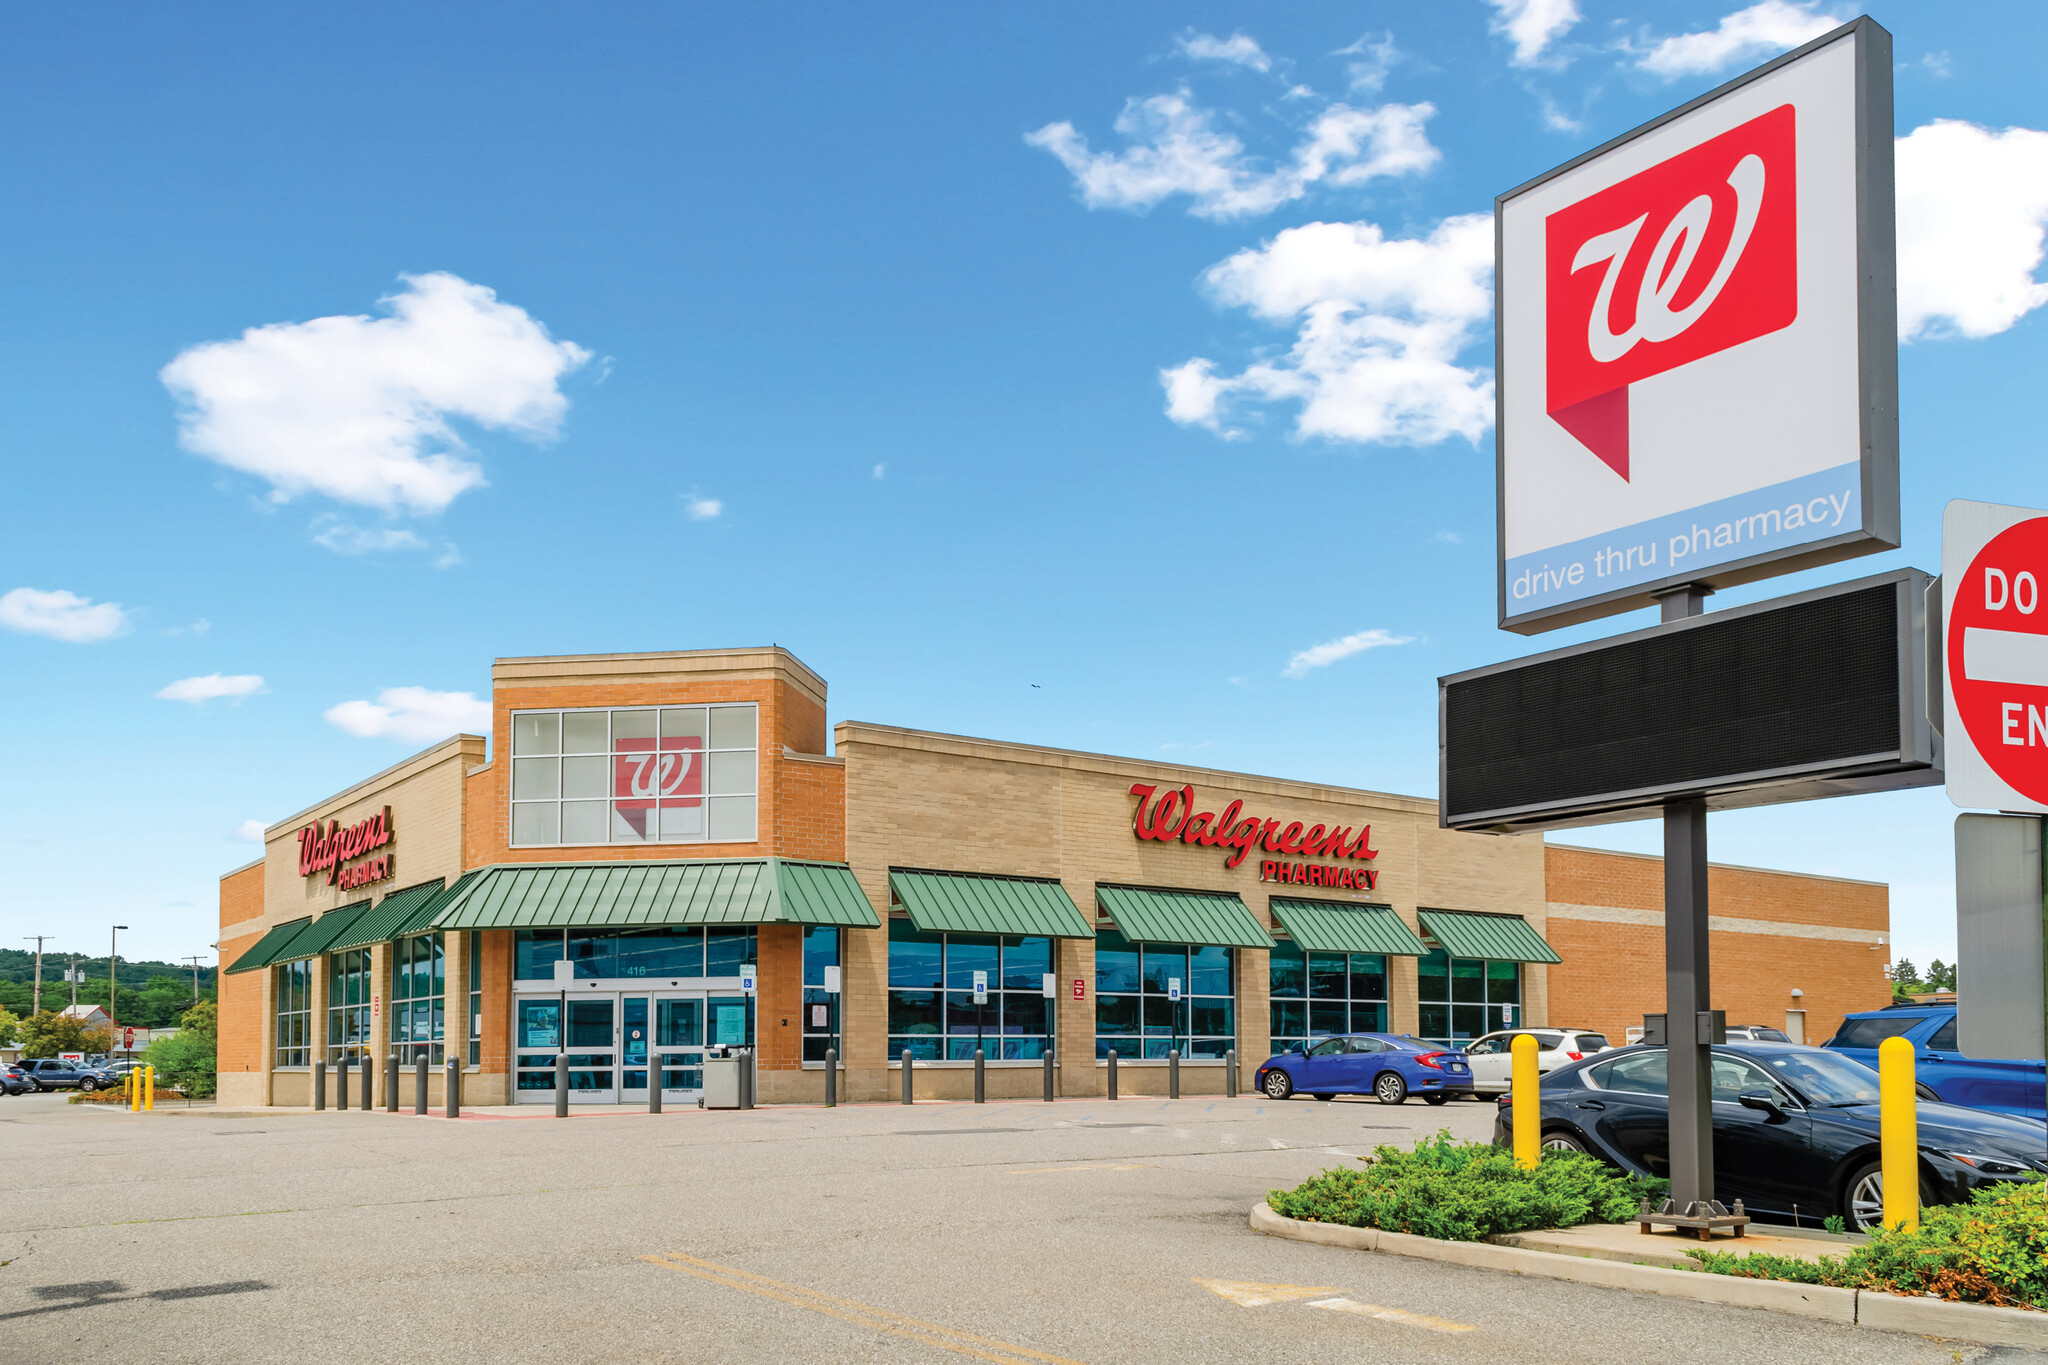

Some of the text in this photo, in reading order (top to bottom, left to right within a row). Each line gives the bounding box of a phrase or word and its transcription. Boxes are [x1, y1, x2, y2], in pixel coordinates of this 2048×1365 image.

[1570, 153, 1766, 363] W
[1512, 489, 1851, 600] drive thru pharmacy
[1985, 567, 2038, 615] DO
[297, 805, 395, 886] Walgreens
[1129, 783, 1379, 869] Walgreens
[339, 854, 394, 891] PHARMACY
[1261, 860, 1379, 890] PHARMACY
